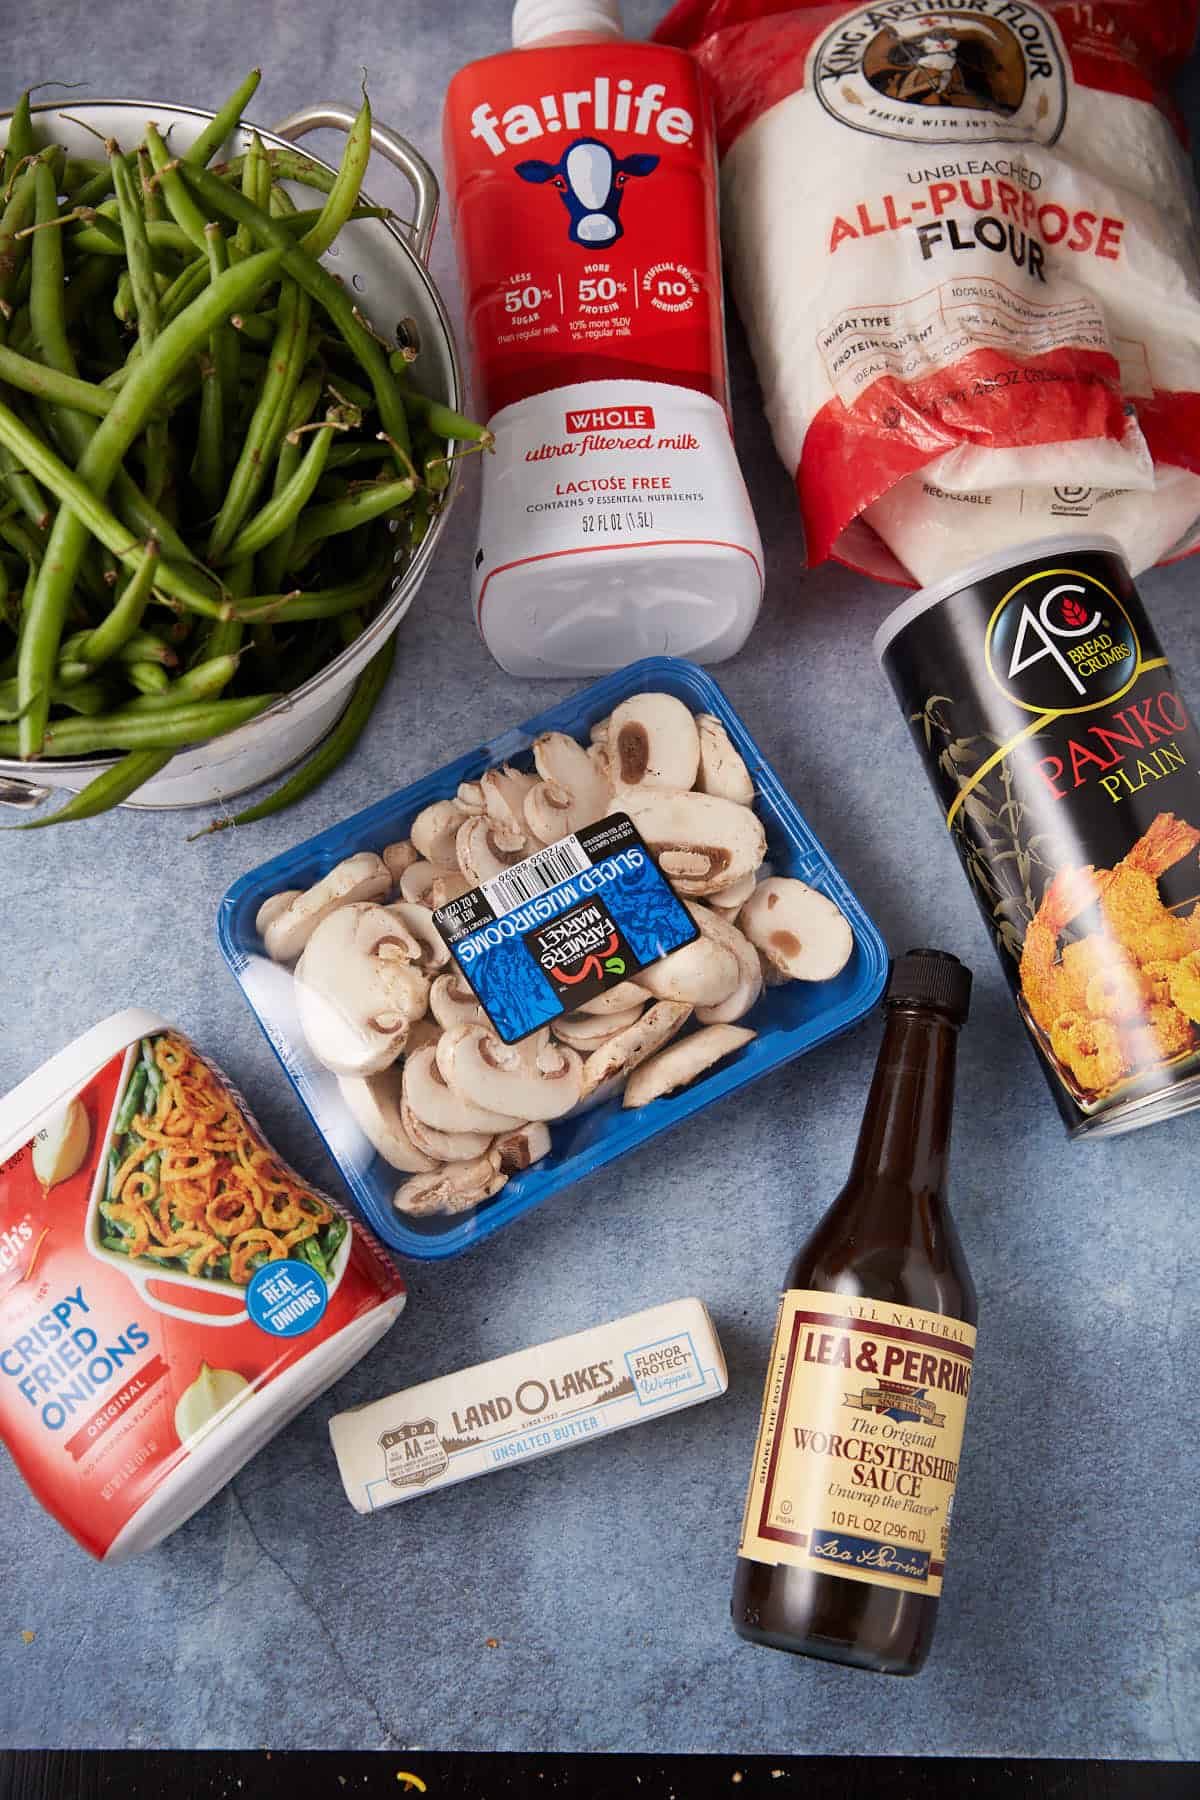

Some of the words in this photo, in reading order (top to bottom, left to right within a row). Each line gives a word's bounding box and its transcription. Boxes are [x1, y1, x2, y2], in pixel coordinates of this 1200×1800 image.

[820, 30, 868, 81] KING
[994, 2, 1052, 81] FLOUR
[922, 119, 958, 128] WITH
[908, 160, 1042, 191] UNBLEACHED
[829, 179, 1124, 260] ALL-PURPOSE
[916, 216, 1048, 283] FLOUR
[510, 272, 531, 284] LESS
[584, 264, 610, 274] MORE
[642, 262, 674, 291] ARTIFICIAL
[505, 286, 552, 312] 50%
[578, 278, 628, 302] 50%
[658, 281, 686, 296] no
[512, 312, 540, 325] SUGAR
[579, 302, 619, 314] PROTEIN
[585, 328, 614, 340] regular
[616, 327, 631, 336] milk
[588, 319, 610, 328] more
[824, 319, 858, 347] WHEAT
[862, 317, 891, 327] TYPE
[832, 340, 880, 372] PROTEIN
[882, 325, 933, 350] CONTENT
[570, 409, 646, 430] WHOLE
[525, 434, 654, 462] ultra-filtered
[658, 433, 700, 450] milk
[556, 476, 626, 496] LACTOSE
[632, 476, 672, 490] FREE
[526, 498, 584, 513] CONTAINS
[588, 497, 594, 505] 9
[596, 495, 643, 504] ESSENTIAL
[647, 493, 704, 502] NUTRIENTS
[582, 515, 594, 532] 52
[598, 514, 608, 531] FL
[611, 513, 622, 530] OZ
[1066, 634, 1112, 664] BREAD
[1078, 643, 1130, 676] CRUMBS
[1034, 691, 1188, 800] PANKO
[1098, 742, 1186, 803] PLAIN
[579, 848, 644, 892] SLICED
[458, 884, 580, 962] MUSHROOMS
[538, 906, 600, 948] MARKET
[540, 918, 616, 970] FARMERS
[262, 1276, 298, 1304] REAL
[272, 1290, 320, 1330] ONIONS
[848, 1306, 878, 1320] ALL
[893, 1313, 964, 1341] NATURAL
[0, 1286, 90, 1376] CRISPY
[18, 1328, 98, 1406] FRIED
[635, 1352, 688, 1380] PROTECT
[636, 1346, 682, 1368] FLAVOR
[42, 1323, 149, 1430] ONIONS
[88, 1380, 146, 1436] ORIGINAL
[451, 1396, 512, 1434] LAND
[516, 1381, 548, 1414] O
[550, 1362, 613, 1402] LAKES
[760, 1439, 772, 1484] SHAKE
[768, 1410, 776, 1432] THE
[774, 1354, 786, 1404] BOTTLE
[850, 1417, 878, 1435] The
[882, 1424, 936, 1448] Original
[405, 1439, 423, 1460] AA
[492, 1432, 551, 1461] UNSALTED
[554, 1415, 598, 1440] BUTTER
[828, 1482, 879, 1508] Unwrap
[882, 1493, 902, 1509] the
[852, 1464, 923, 1498] SAUCE
[832, 1511, 845, 1524] 10
[848, 1514, 860, 1529] FL
[864, 1518, 882, 1533] OZ
[884, 1520, 910, 1539] (296
